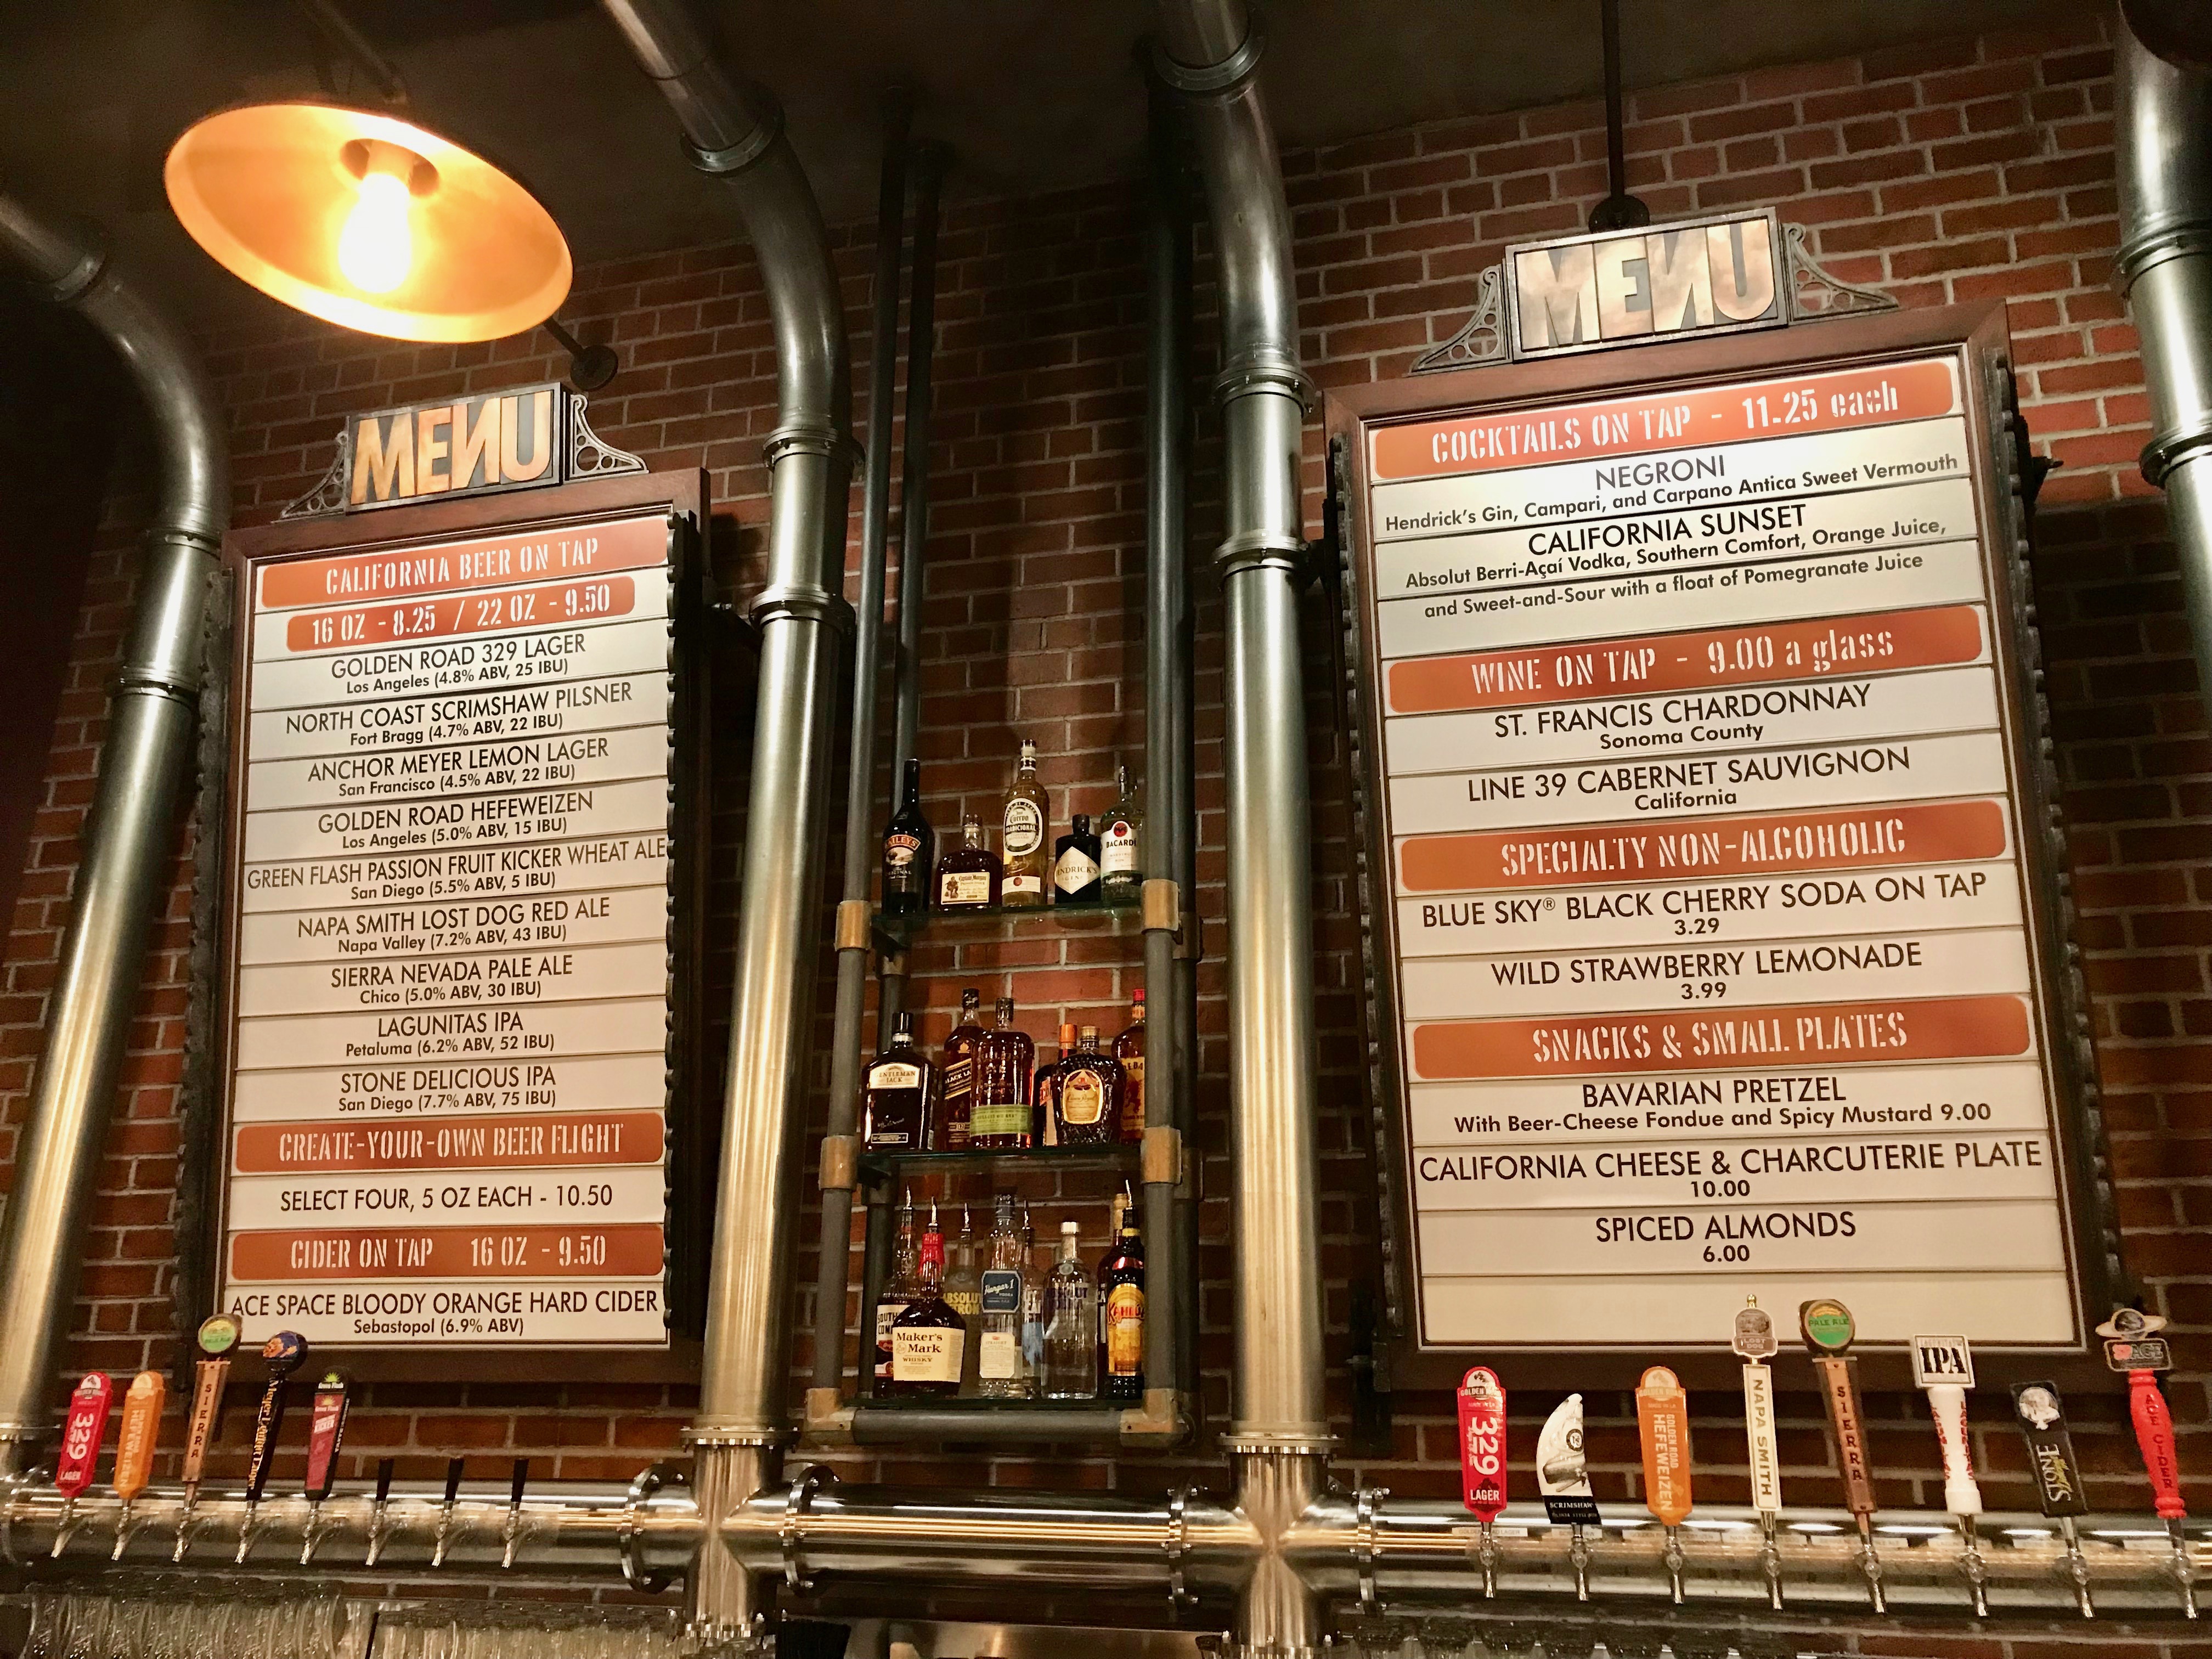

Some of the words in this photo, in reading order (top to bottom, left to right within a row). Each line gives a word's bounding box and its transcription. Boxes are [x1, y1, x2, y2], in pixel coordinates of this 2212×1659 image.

[1596, 455, 1725, 490] NEGRONI
[1386, 509, 1476, 531] Hendrick's
[1482, 505, 1519, 522] Gin,
[1524, 495, 1606, 518] Campari,
[1612, 490, 1647, 509] and
[1653, 486, 1733, 505] Carpano
[1739, 475, 1796, 495] Antica
[1802, 467, 1858, 487] Sweet
[1863, 453, 1957, 479] Vermouth
[1528, 517, 1693, 556] CALIFORNIA
[1701, 504, 1806, 537] SUNSET
[326, 556, 450, 595] CALIFORNIA
[460, 549, 510, 580] BEER
[520, 544, 548, 572] ON
[558, 538, 598, 567] TAP
[1406, 568, 1471, 589] Absolut
[1476, 557, 1562, 582] Berri-Açaí
[1567, 552, 1631, 572] Vodka,
[1637, 544, 1719, 565] Southern
[1725, 533, 1806, 555] Comfort,
[1812, 527, 1885, 545] Orange
[1891, 518, 1946, 537] Juice,
[331, 652, 413, 679] GOLDEN
[420, 646, 475, 670] ROAD
[482, 641, 517, 663] 329
[525, 633, 586, 658] LAGER
[347, 681, 369, 694] Los
[373, 674, 430, 693] Angeles
[435, 669, 475, 689] (4.8%
[478, 664, 510, 681] ABV,
[515, 662, 533, 676] 25
[539, 658, 568, 675] IBU)
[286, 710, 353, 734] NORTH
[360, 704, 426, 728] COAST
[431, 691, 549, 722] SCRIMSHAW
[556, 681, 633, 709] PILSNER
[1494, 713, 1527, 738] ST.
[1538, 702, 1653, 734] FRANCIS
[1663, 683, 1871, 724] CHARDONNAY
[1600, 732, 1683, 749] Sonoma
[1690, 723, 1764, 742] County
[338, 783, 365, 797] San
[370, 777, 435, 794] Francisco
[440, 772, 481, 792] (4.5%
[484, 769, 517, 786] ABV,
[522, 767, 540, 782] 22
[545, 764, 575, 781] IBU)
[1468, 776, 1525, 802] LINE
[1535, 772, 1566, 797] 39
[1577, 761, 1718, 794] CABERNET
[1728, 746, 1910, 783] SAUVIGNON
[1634, 788, 1737, 811] California
[887, 837, 917, 847] AILEYS
[1501, 836, 1647, 876] SPECIALTY
[1658, 819, 1905, 867] NON-ALCOHOLIC
[247, 867, 303, 889] GREEN
[310, 863, 362, 885] FLASH
[368, 857, 442, 881] PASSION
[448, 852, 496, 876] FRUIT
[501, 847, 562, 871] KICKER
[567, 840, 629, 865] WHEAT
[634, 837, 665, 860] ALE
[338, 939, 377, 956] Napa
[382, 935, 426, 952] Valley
[431, 931, 471, 951] (7.2%
[475, 929, 508, 945] ABV,
[512, 927, 531, 941] 43
[537, 924, 567, 942] IBU)
[1674, 917, 1719, 935] 3.29
[1491, 961, 1560, 986] WILD
[1570, 944, 1745, 983] STRAWBERRY
[1754, 942, 1922, 974] LEMONADE
[1681, 981, 1726, 1000] 3.99
[378, 1012, 487, 1037] LAGUNITAS
[495, 1011, 524, 1032] IPA
[346, 1041, 412, 1057] Petaluma
[417, 1038, 458, 1057] (6.2%
[462, 1036, 495, 1053] ABV,
[500, 1035, 518, 1050] 52
[524, 1034, 554, 1052] IBU)
[341, 1071, 406, 1093] STONE
[413, 1066, 519, 1091] DELICIOUS
[527, 1065, 556, 1086] IPA
[1582, 1080, 1722, 1108] BAVARIAN
[1733, 1076, 1847, 1104] PRETZEL
[1454, 1115, 1500, 1133] With
[1508, 1112, 1638, 1132] Beer-Cheese
[1646, 1109, 1724, 1128] Fondue
[1731, 1108, 1772, 1126] and
[1779, 1107, 1835, 1129] Spicy
[1842, 1103, 1932, 1123] Mustard
[1940, 1103, 1991, 1121] 9.00
[279, 1128, 485, 1161] CREATE-YOUR-OWN
[493, 1126, 544, 1156] BEER
[551, 1123, 624, 1154] FLIGHT
[1596, 1216, 1694, 1243] SPICED
[1704, 1211, 1856, 1240] ALMONDS
[1703, 1244, 1750, 1262] 6.00
[232, 1295, 270, 1317] ACE
[276, 1294, 336, 1316] SPACE
[343, 1293, 427, 1315] BLOODY
[433, 1291, 522, 1314] ORANGE
[530, 1291, 588, 1313] HARD
[595, 1290, 658, 1313] CIDER
[354, 1318, 435, 1337] Sebastopol
[441, 1318, 483, 1337] (6.9%
[487, 1317, 523, 1337] ABV)
[896, 1333, 943, 1341] Maker's
[907, 1344, 942, 1353] Mark
[1920, 1347, 1967, 1374] IPA
[191, 1384, 212, 1458] SIERRA
[1753, 1379, 1767, 1429] NAPA
[67, 1413, 94, 1460] 329
[1471, 1416, 1500, 1475] 329
[1666, 1414, 1677, 1444] GOLDEN
[1837, 1386, 1863, 1480] SIERRA
[1654, 1414, 1673, 1511] HEFEWEIZEN
[1669, 1447, 1679, 1468] ROAD
[1757, 1436, 1773, 1496] SMITH
[2036, 1444, 2072, 1502] STONE
[2152, 1434, 2173, 1488] CIDER
[1470, 1489, 1500, 1502] LAGER
